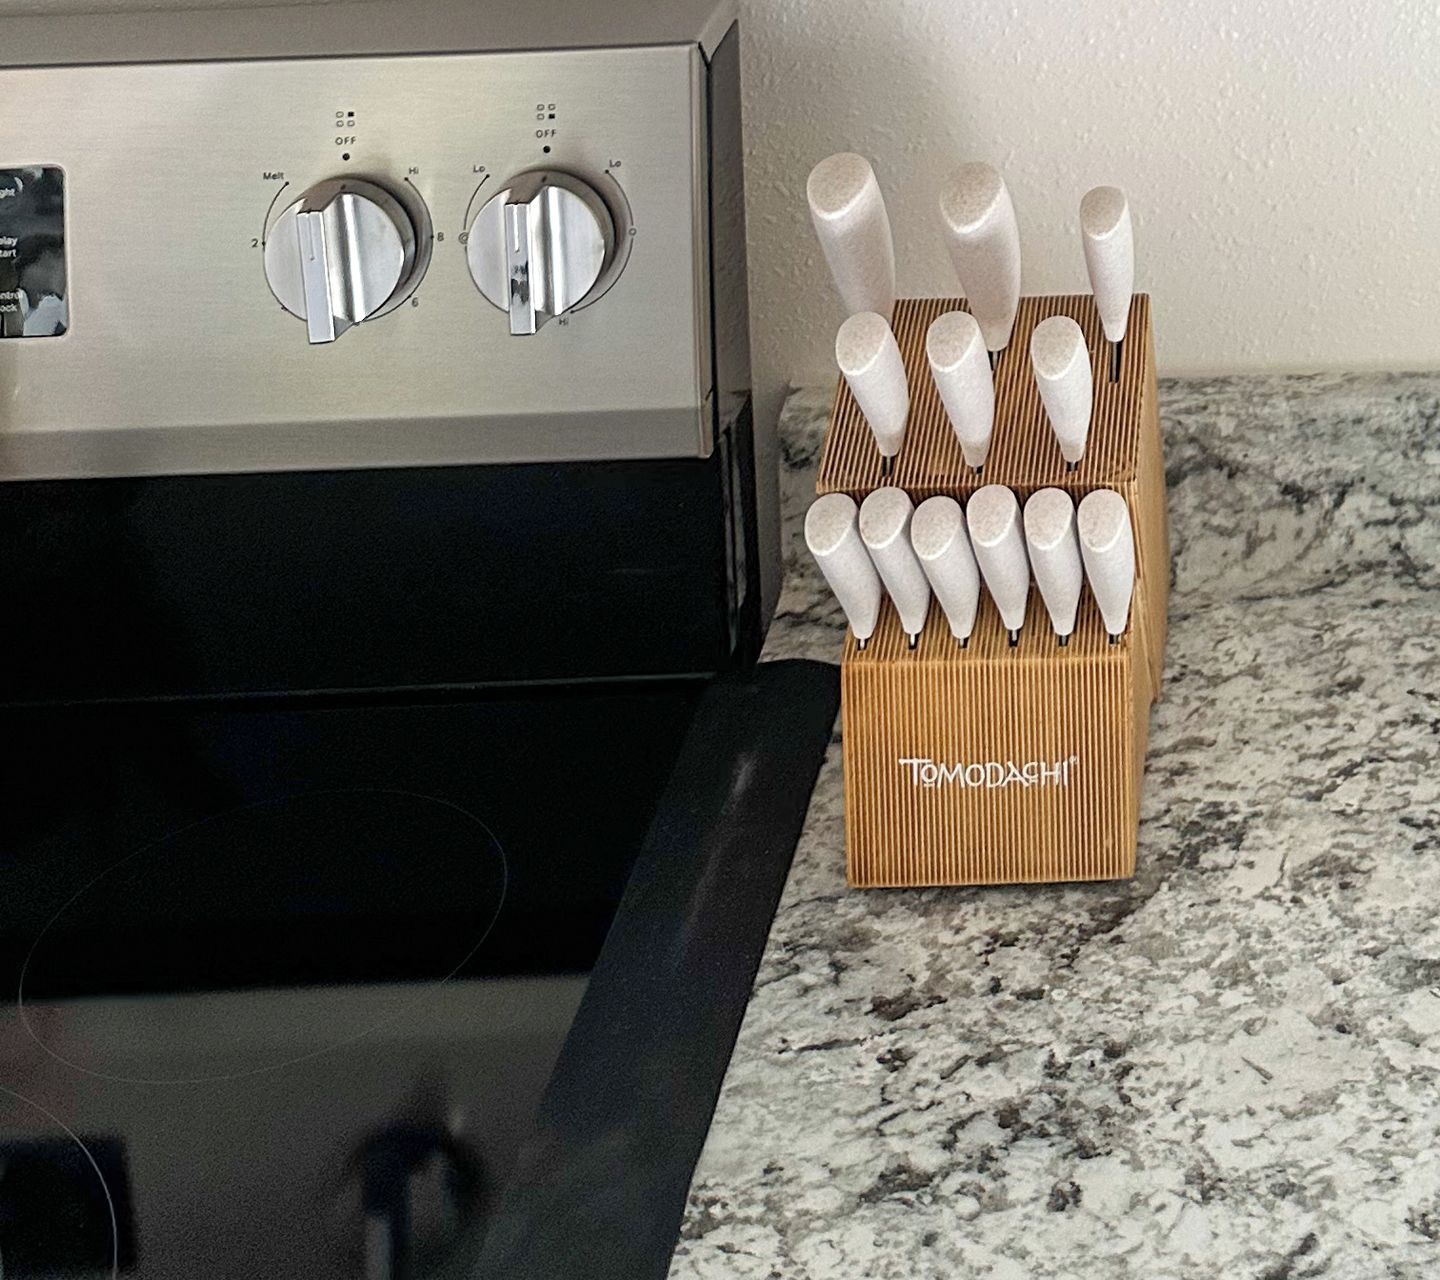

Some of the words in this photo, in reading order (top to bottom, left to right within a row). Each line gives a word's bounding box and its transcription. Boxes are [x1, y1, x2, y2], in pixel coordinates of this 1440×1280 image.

[535, 130, 557, 138] OFF
[335, 137, 356, 145] OFF
[609, 160, 622, 168] Lo
[409, 167, 419, 175] Hi
[473, 165, 485, 173] Lo
[263, 172, 284, 180] Melt
[252, 239, 258, 247] 2
[412, 298, 418, 307] 6
